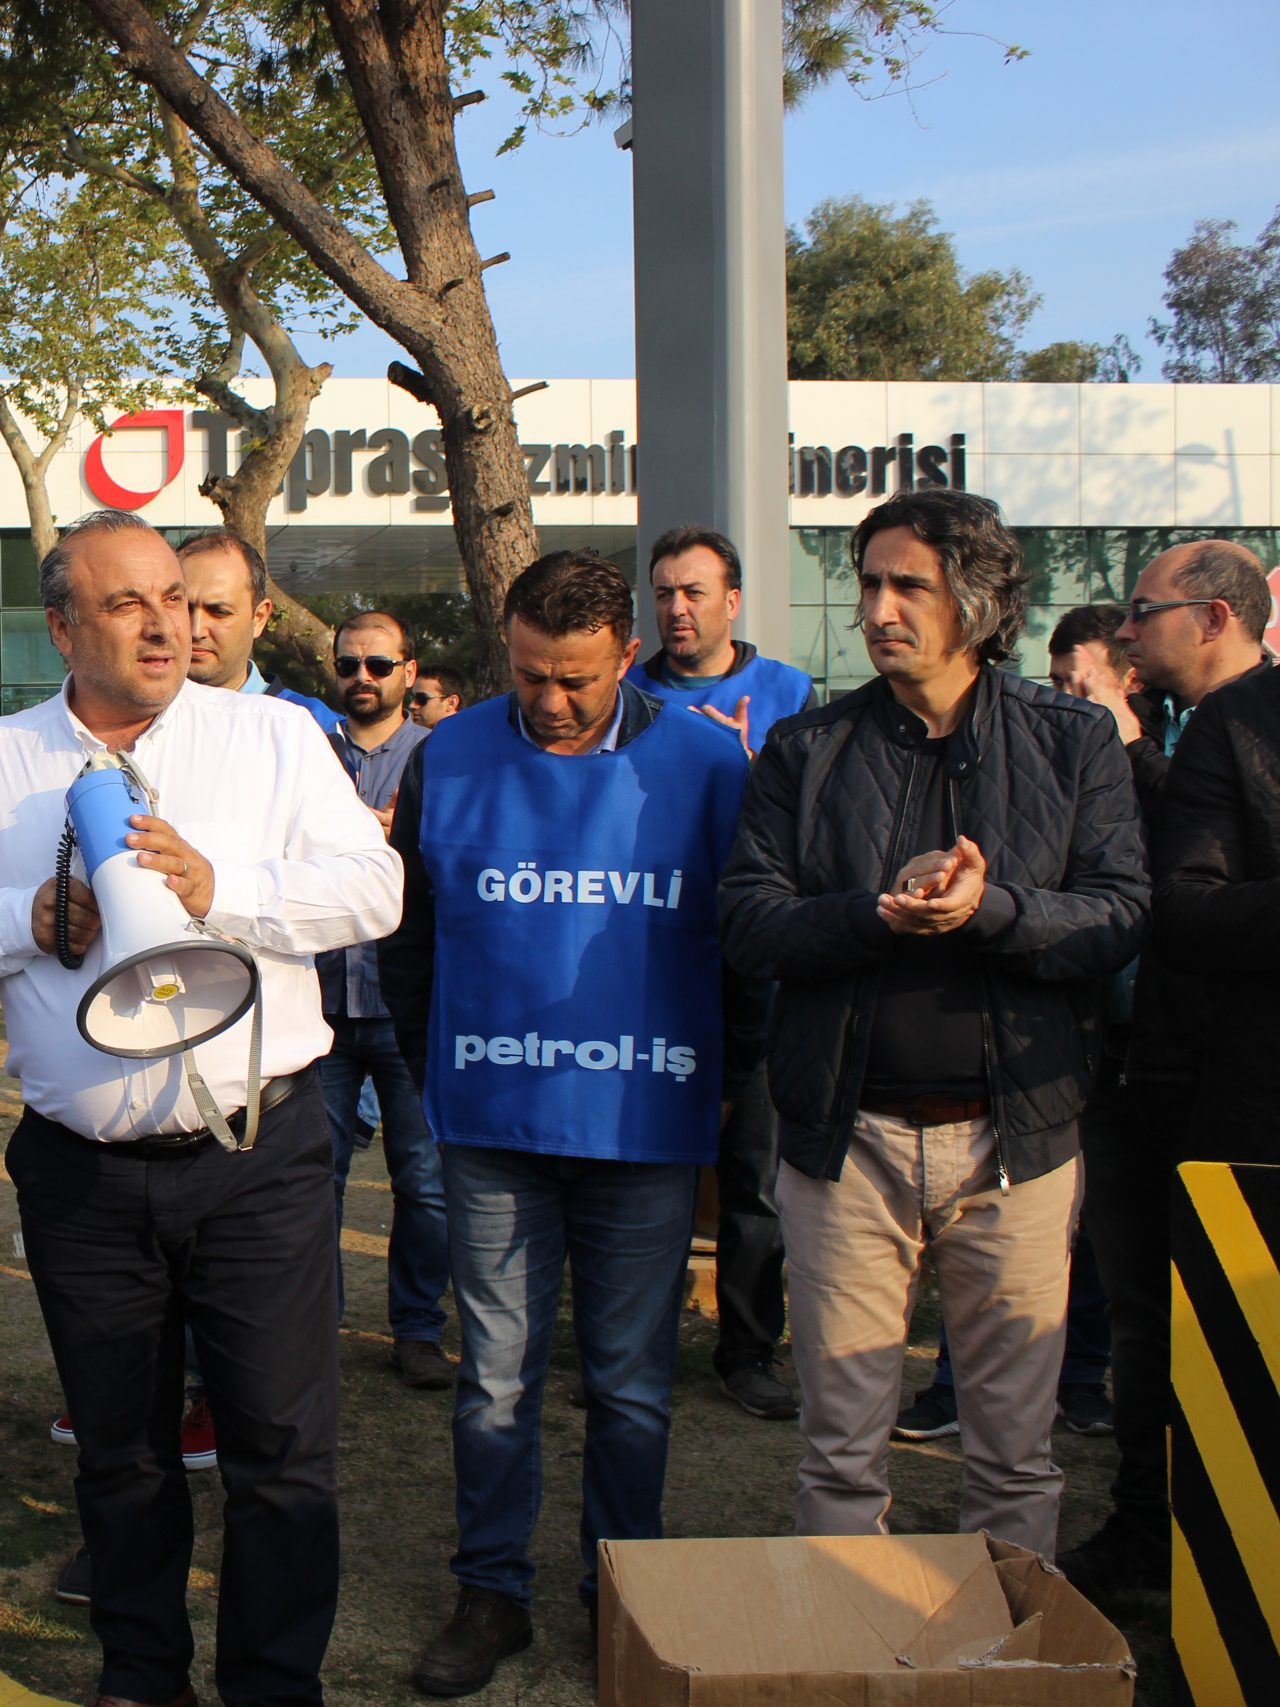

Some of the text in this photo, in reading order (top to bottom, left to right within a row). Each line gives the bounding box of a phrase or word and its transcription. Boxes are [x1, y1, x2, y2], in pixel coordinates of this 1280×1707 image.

[521, 429, 637, 493] zmi
[476, 861, 683, 909] GÖREVLİ
[455, 1031, 697, 1082] petrol-iş
